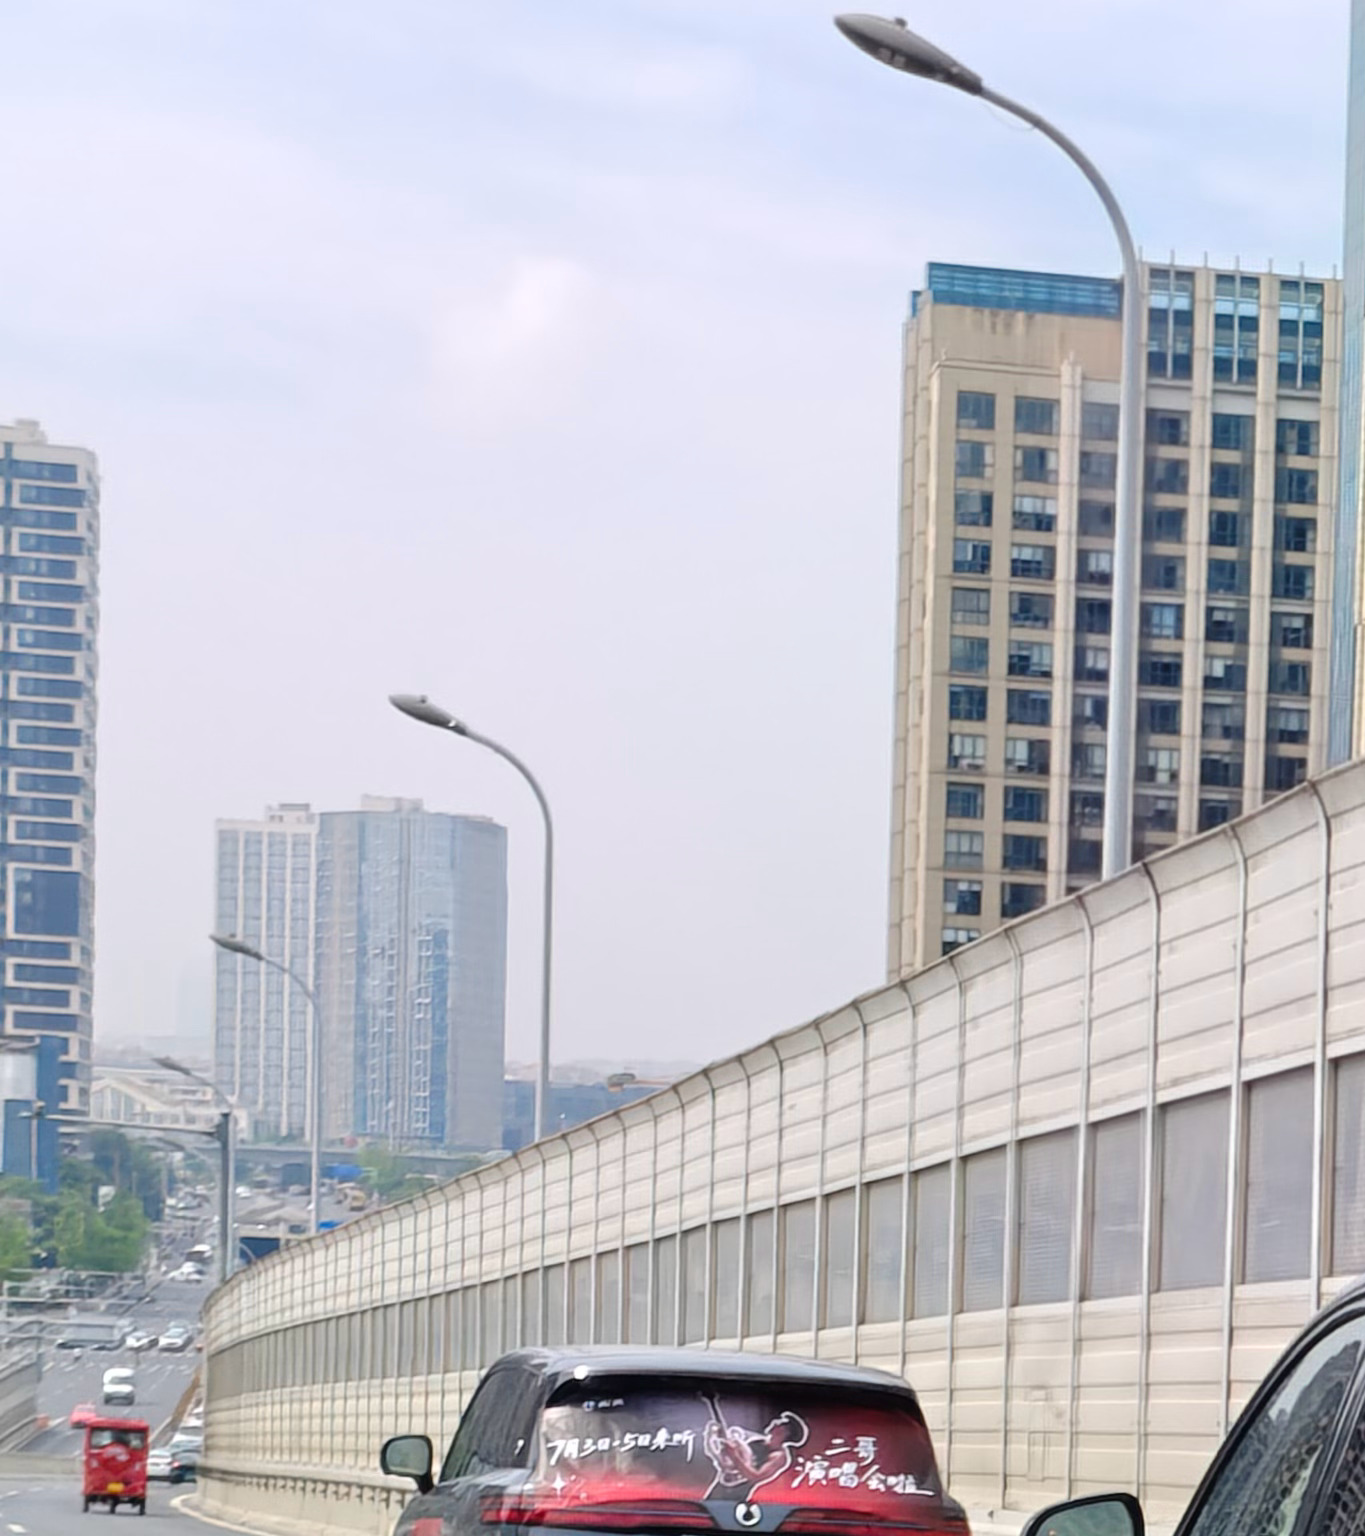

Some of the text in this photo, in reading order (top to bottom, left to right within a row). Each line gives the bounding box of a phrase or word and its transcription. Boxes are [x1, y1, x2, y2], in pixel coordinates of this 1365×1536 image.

[824, 1436, 878, 1466] 二哥
[790, 1455, 935, 1496] 演唱会啦
